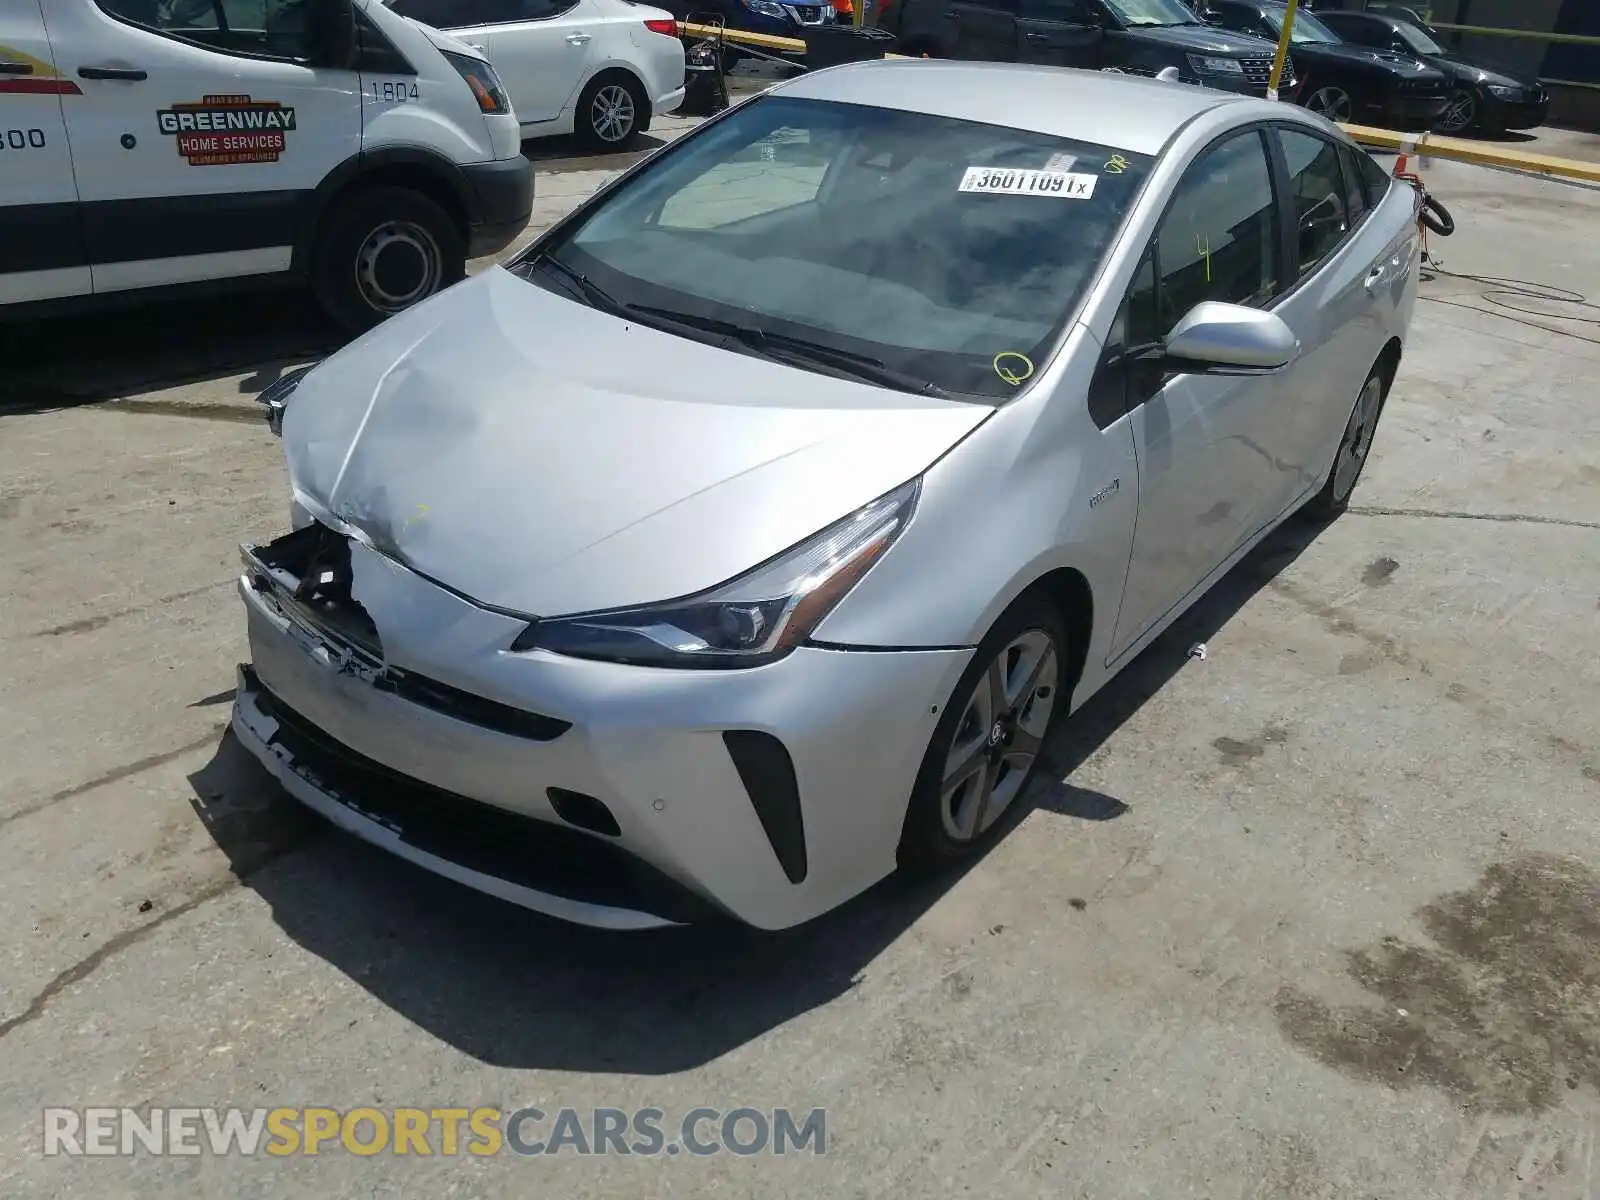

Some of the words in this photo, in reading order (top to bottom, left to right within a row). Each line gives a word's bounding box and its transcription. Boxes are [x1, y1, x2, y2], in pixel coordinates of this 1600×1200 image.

[372, 82, 419, 102] 1804
[160, 110, 293, 131] GREENWAY
[0, 128, 46, 150] 00
[181, 138, 219, 151] HOME
[223, 135, 282, 150] SERVICES
